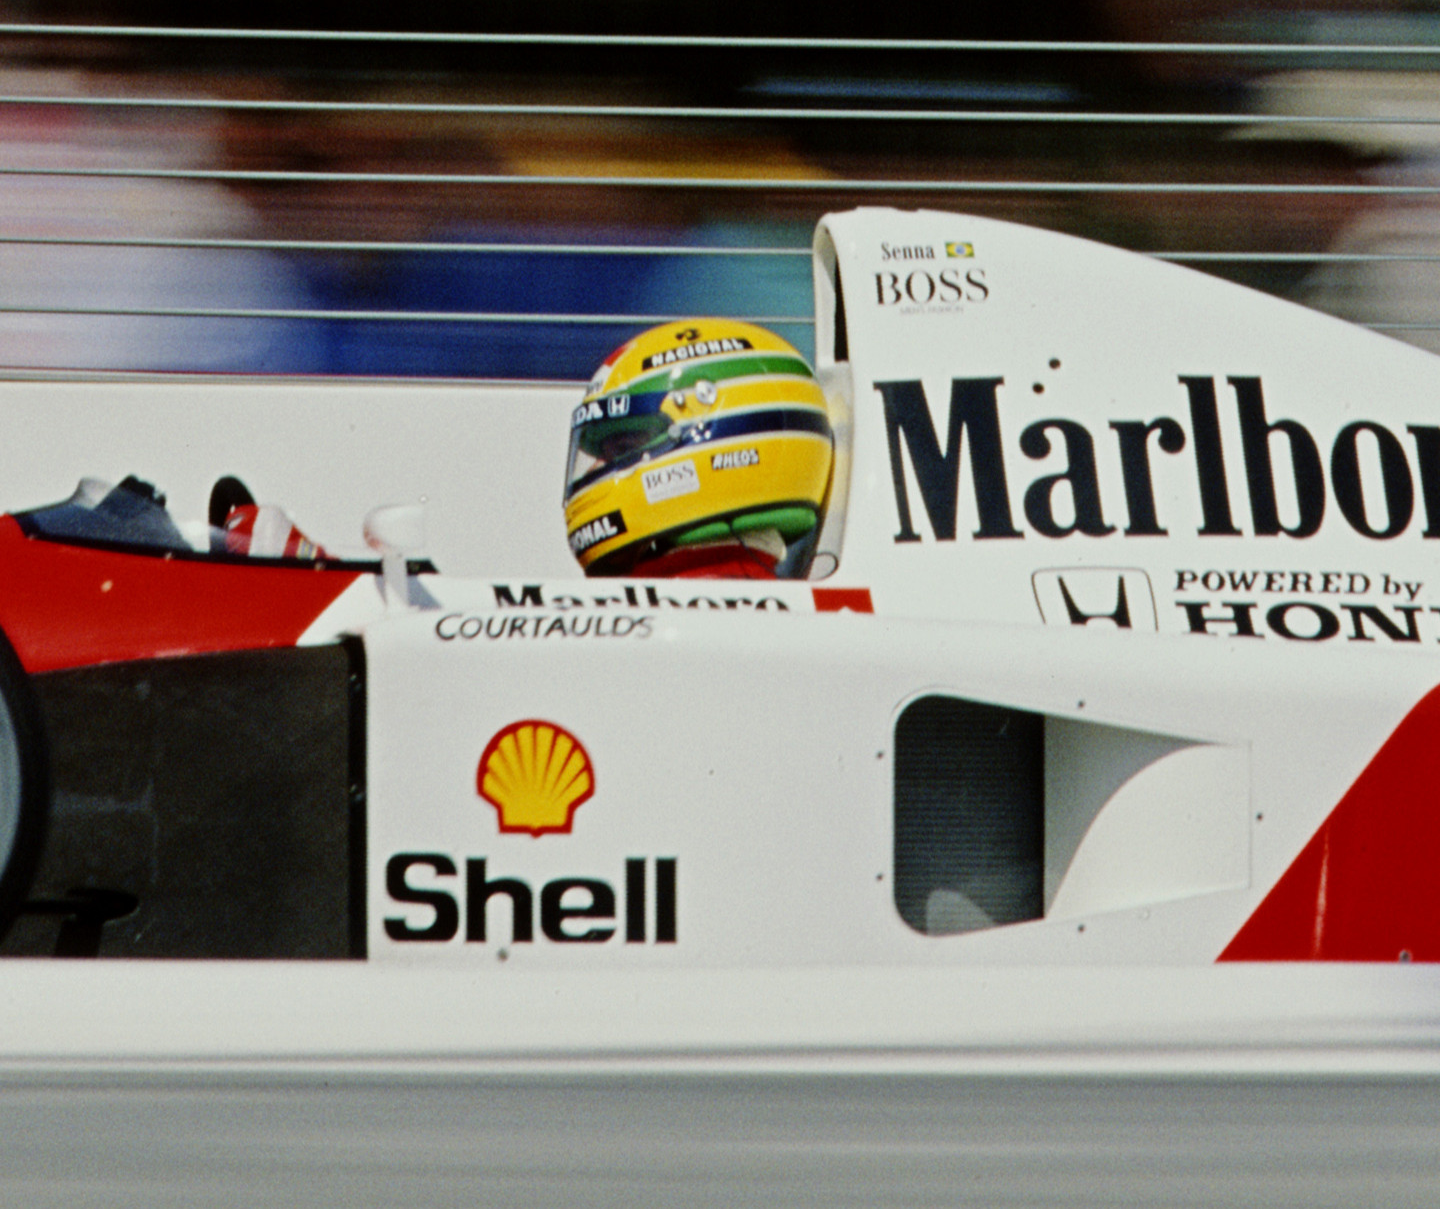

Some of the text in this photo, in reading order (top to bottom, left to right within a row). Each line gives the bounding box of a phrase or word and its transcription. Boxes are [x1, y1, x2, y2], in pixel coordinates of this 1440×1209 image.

[880, 241, 936, 261] Senna
[874, 268, 990, 305] BOSS
[645, 464, 695, 490] BOSS
[1174, 569, 1424, 601] POWERED by
[382, 851, 678, 944] Shell
